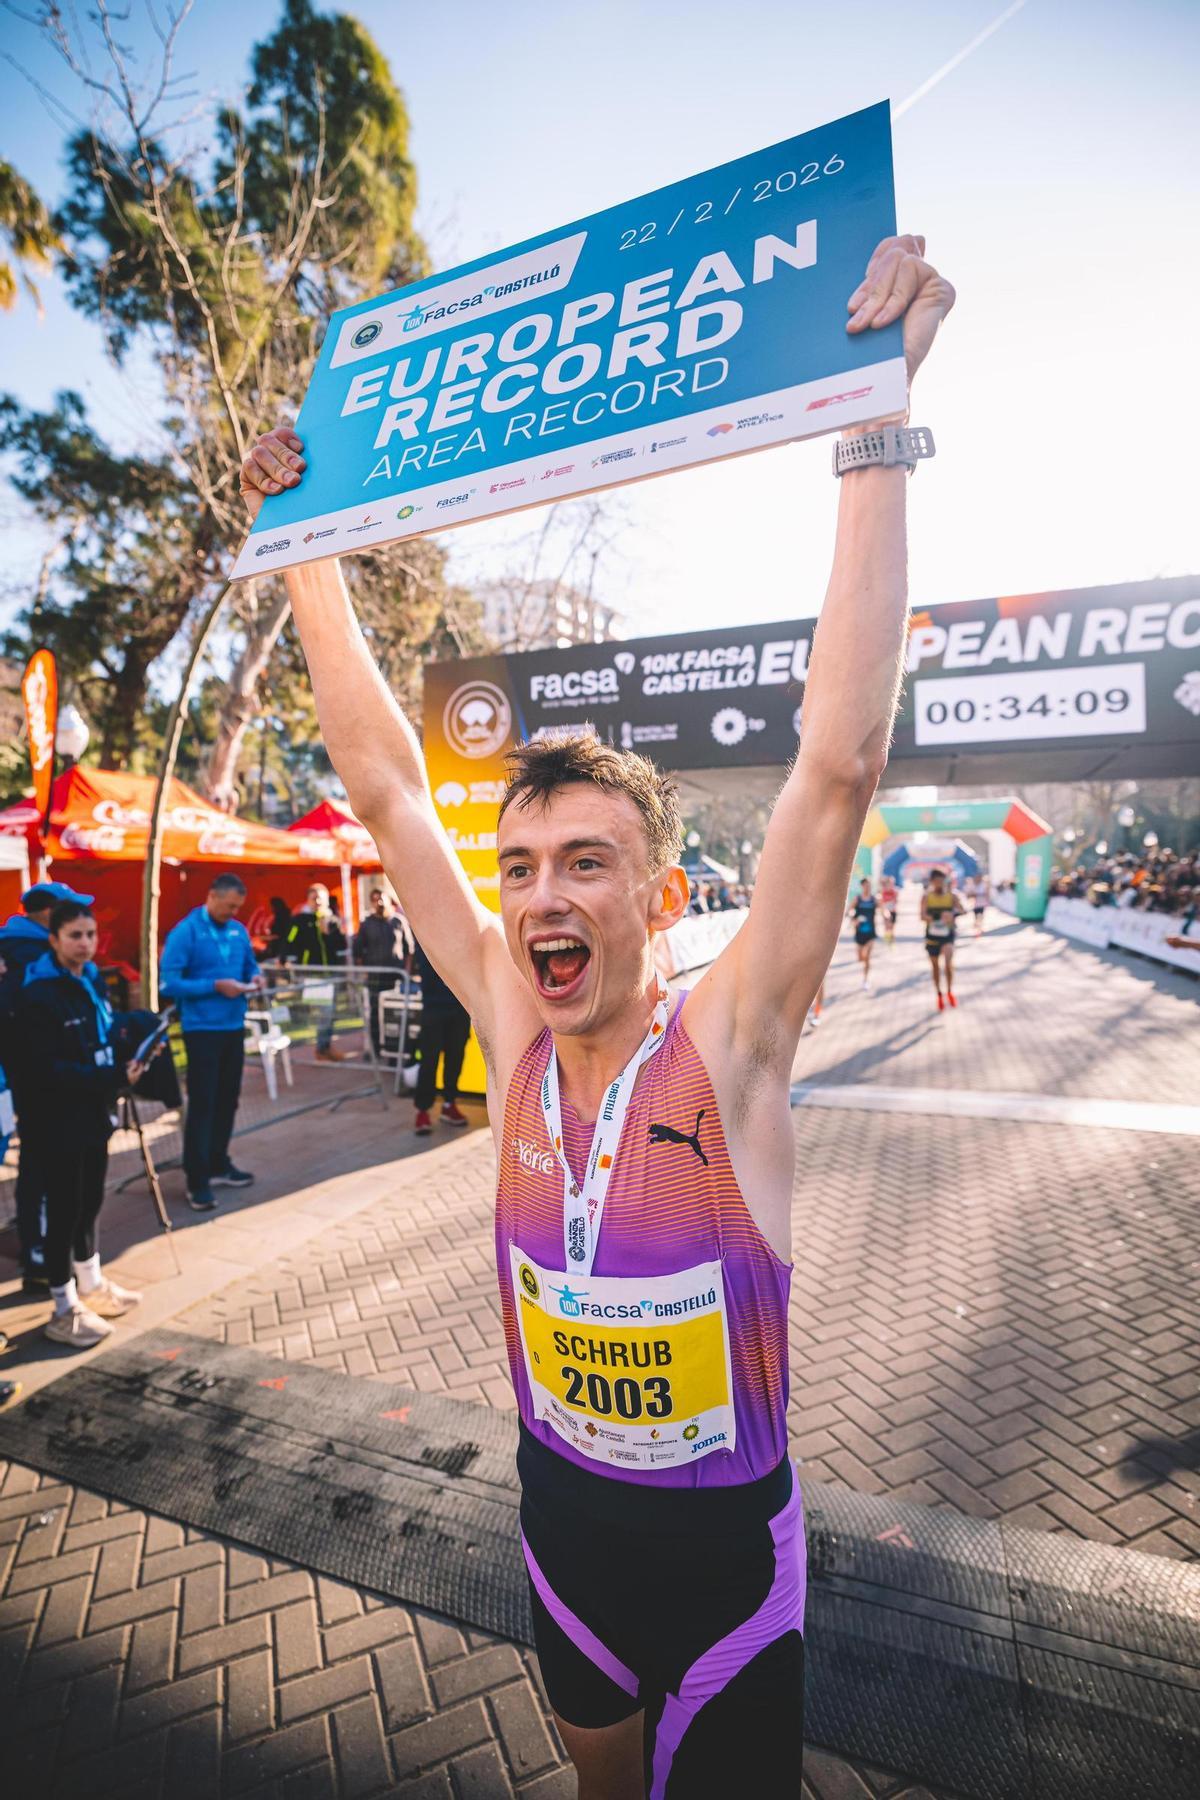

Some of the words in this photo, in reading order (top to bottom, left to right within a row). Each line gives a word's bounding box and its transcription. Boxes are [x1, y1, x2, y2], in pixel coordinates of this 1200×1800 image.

[619, 222, 657, 250] 22
[694, 201, 713, 224] 2
[752, 153, 845, 203] 2026
[494, 263, 560, 299] CASTELLÓ
[340, 218, 818, 417] EUROPEAN
[373, 299, 744, 450] RECORD
[362, 427, 487, 486] AREA
[503, 357, 729, 447] RECORD
[640, 652, 681, 675] 10K
[682, 643, 757, 672] FACSA
[530, 667, 620, 701] Facsa
[641, 664, 757, 696] CASTELLÓ
[926, 688, 1131, 725] 00:34:09
[603, 1083, 621, 1121] CASTELLÓ
[561, 1299, 579, 1315] 10K
[654, 1287, 717, 1318] CASTELLÓ
[552, 1330, 673, 1369] SCHRUB
[561, 1366, 673, 1420] 2003
